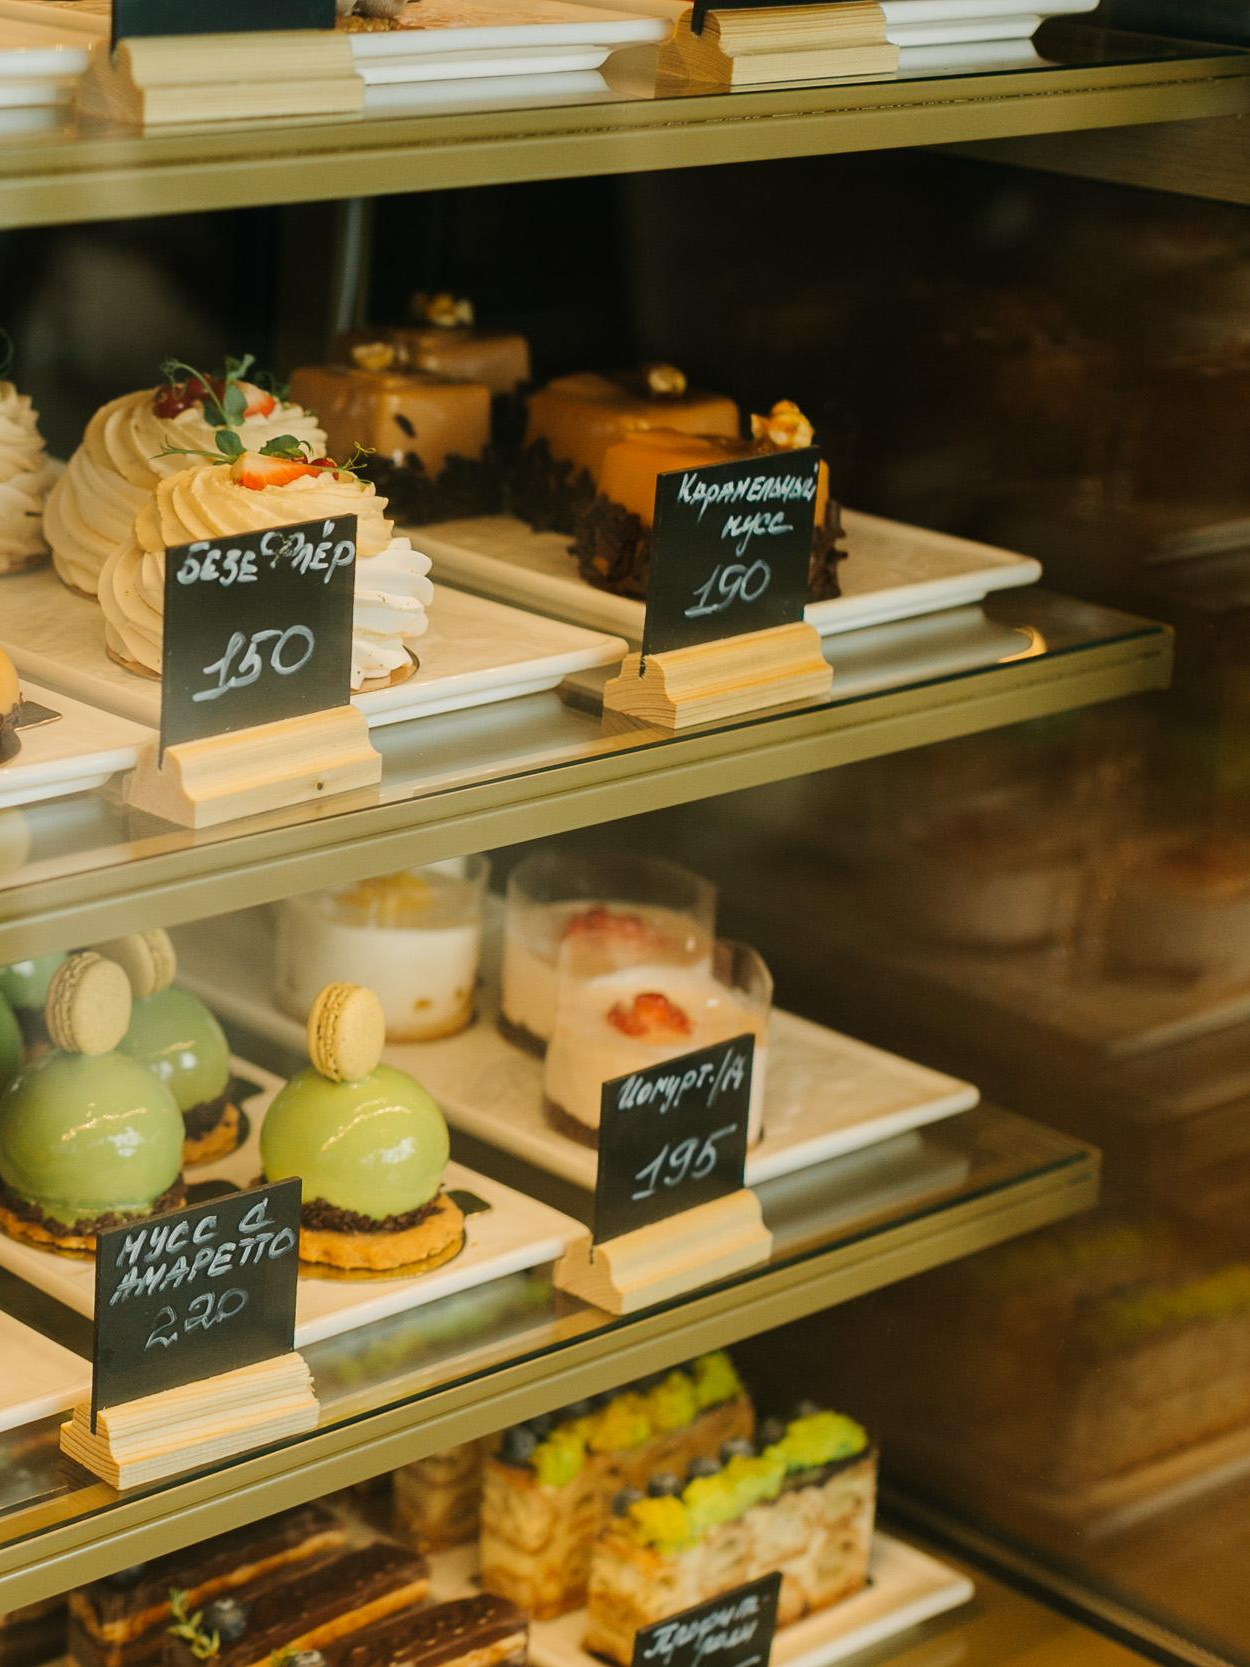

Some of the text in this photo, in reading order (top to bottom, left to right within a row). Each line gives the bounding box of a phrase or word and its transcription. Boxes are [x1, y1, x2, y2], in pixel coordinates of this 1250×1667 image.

[684, 559, 771, 618] 190
[192, 625, 315, 702] 150
[631, 1122, 738, 1200] 195
[110, 1227, 296, 1306] АМАРЕТТО
[116, 1215, 218, 1268] МУСС
[144, 1288, 248, 1351] 220
